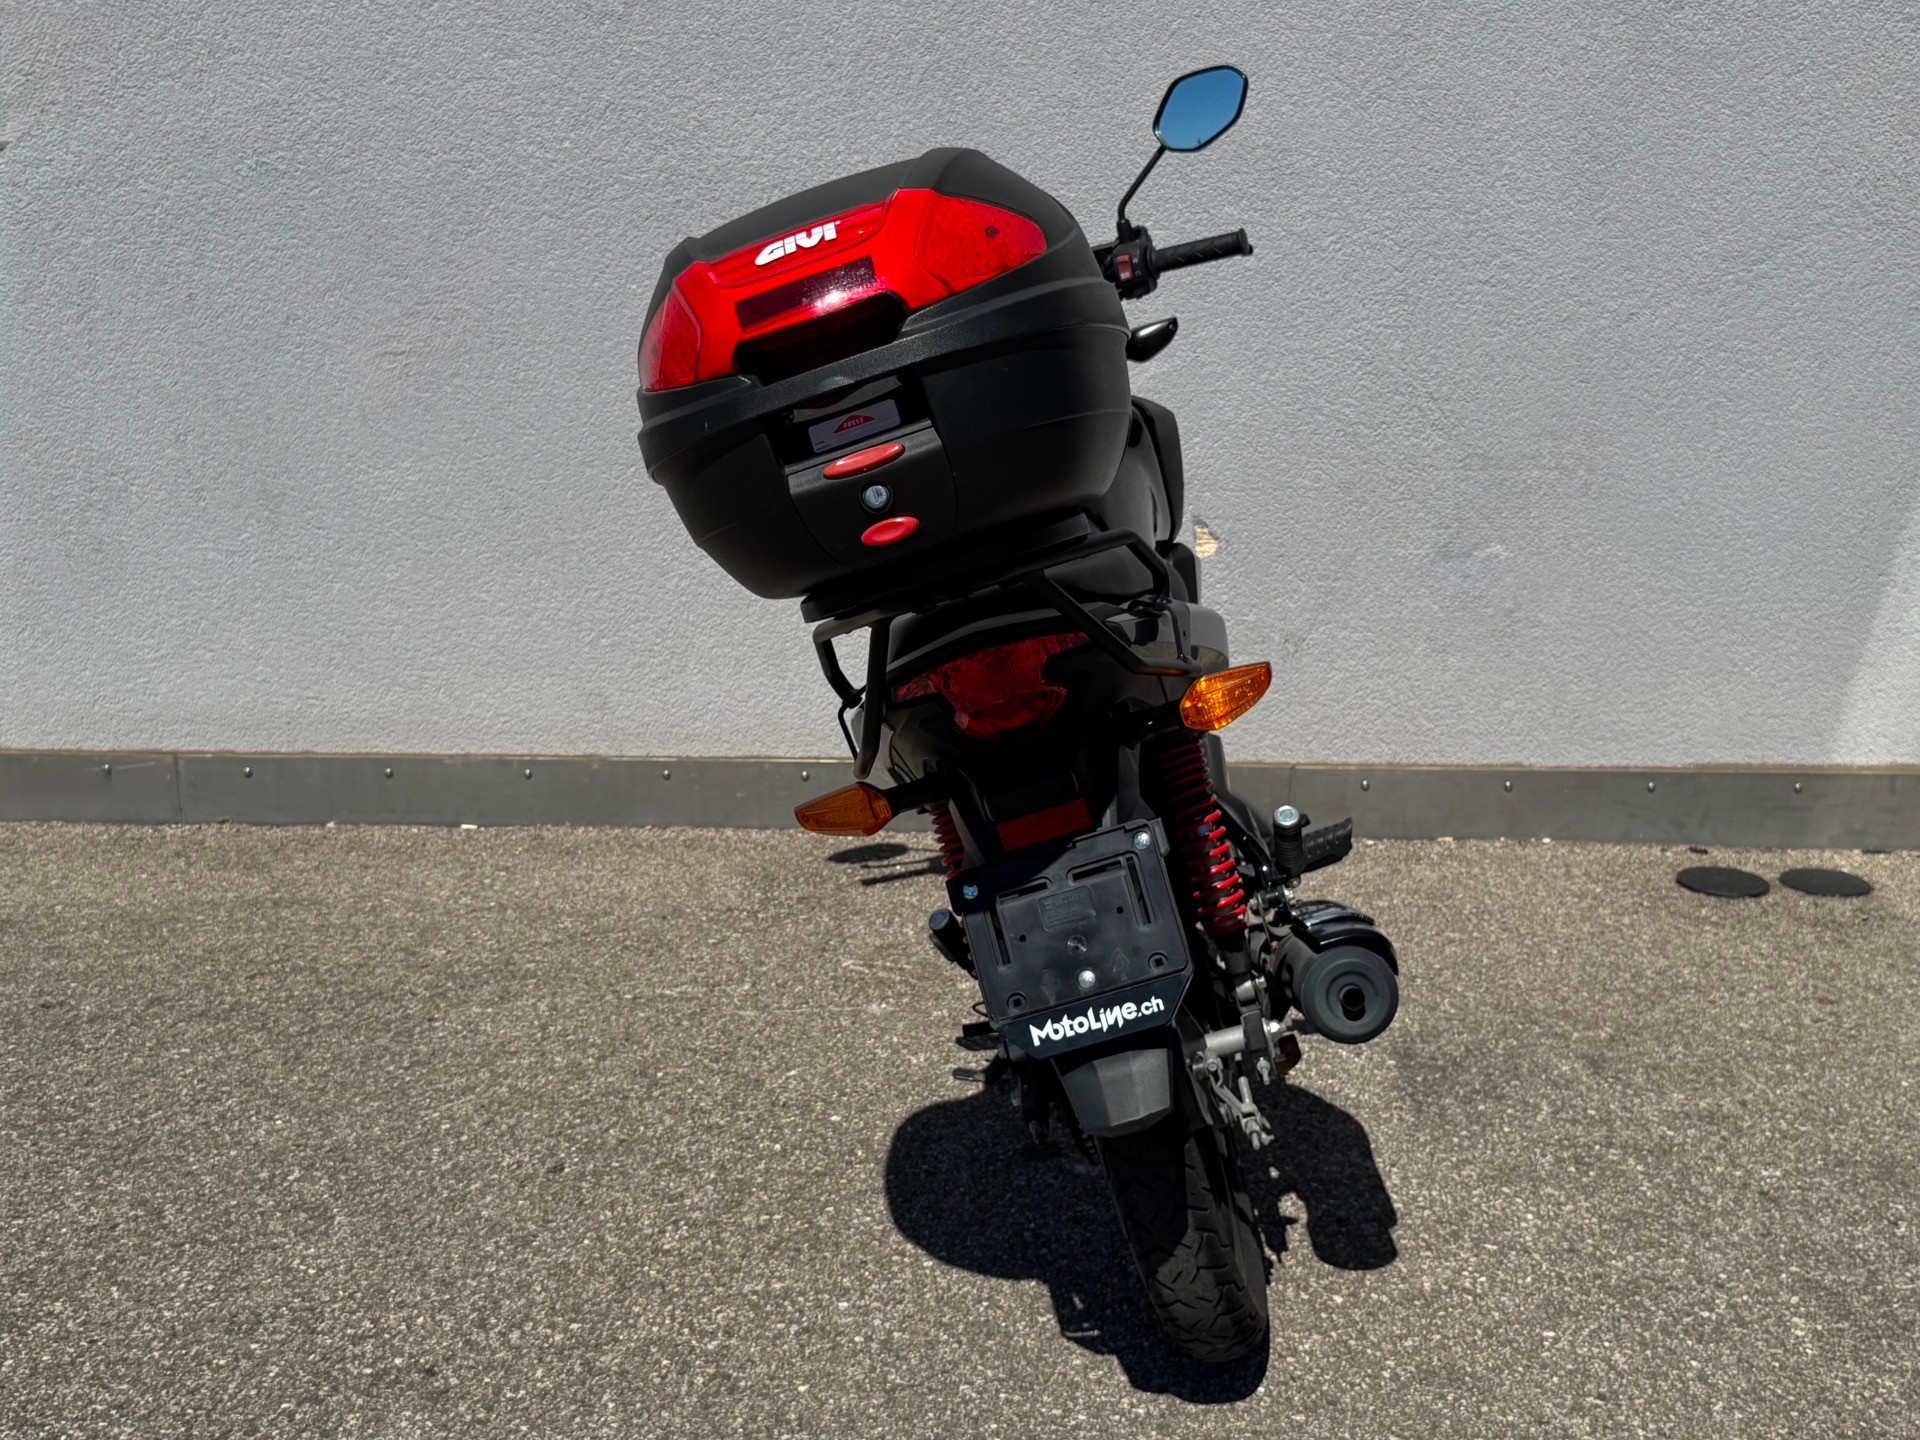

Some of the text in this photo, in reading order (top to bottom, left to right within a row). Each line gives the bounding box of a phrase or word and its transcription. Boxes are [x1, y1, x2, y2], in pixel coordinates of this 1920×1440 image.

[754, 221, 837, 266] GIVI
[843, 416, 865, 429] PRESS
[1029, 995, 1165, 1047] MotoLine.ch
